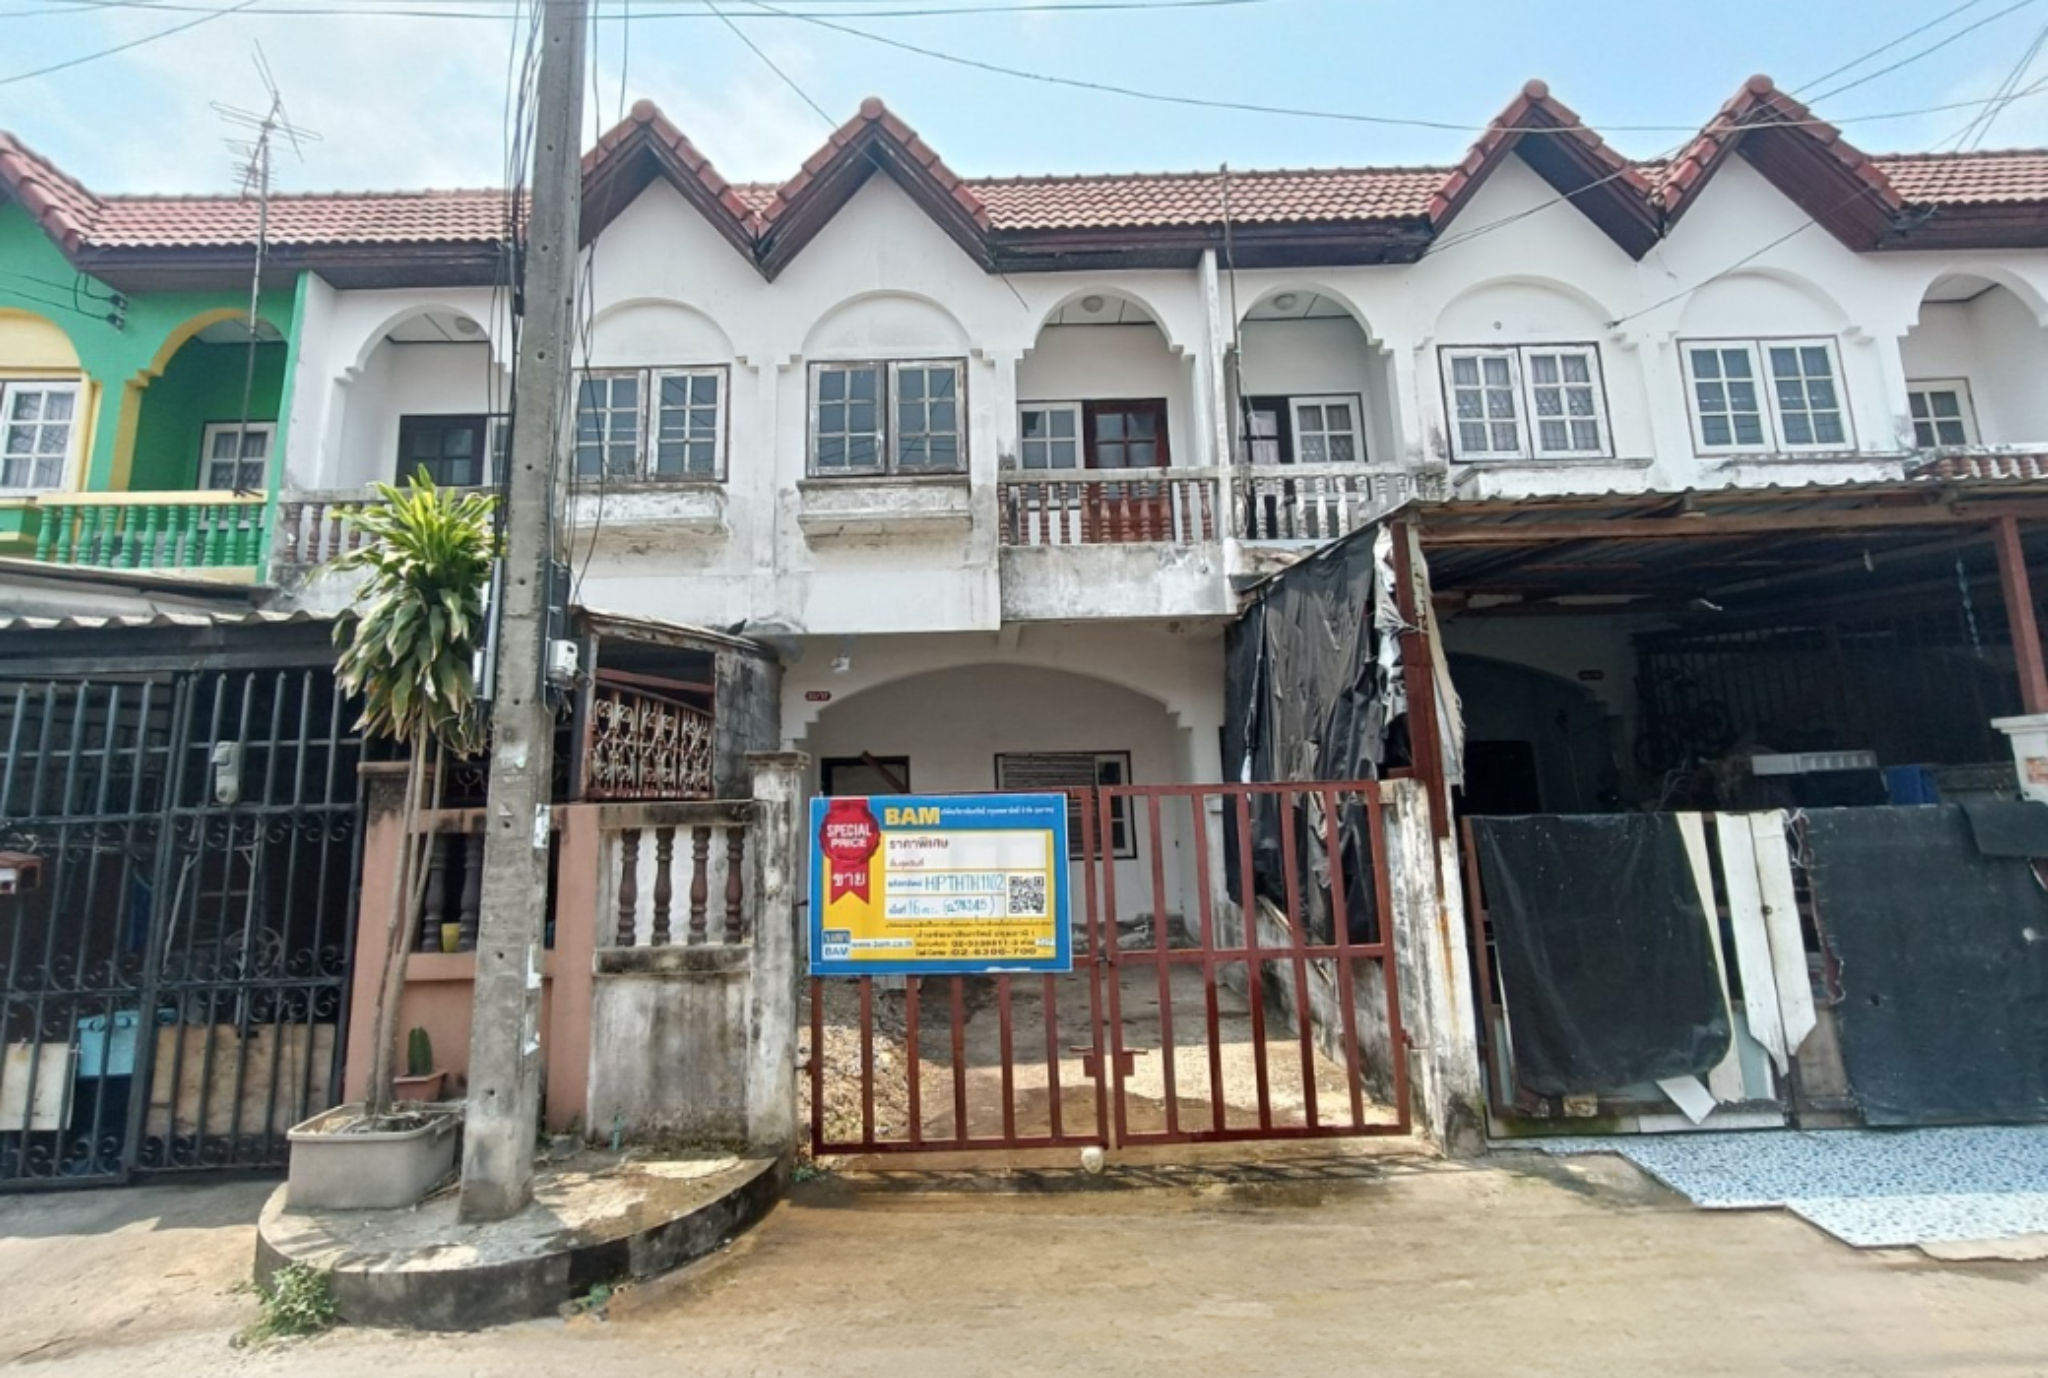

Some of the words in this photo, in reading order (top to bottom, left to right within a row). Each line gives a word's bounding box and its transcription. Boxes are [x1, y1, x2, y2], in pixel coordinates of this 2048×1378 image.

[884, 807, 941, 826] BAM
[826, 824, 872, 838] SPECIAL
[830, 837, 868, 848] PRICE
[832, 871, 866, 887] ขาย
